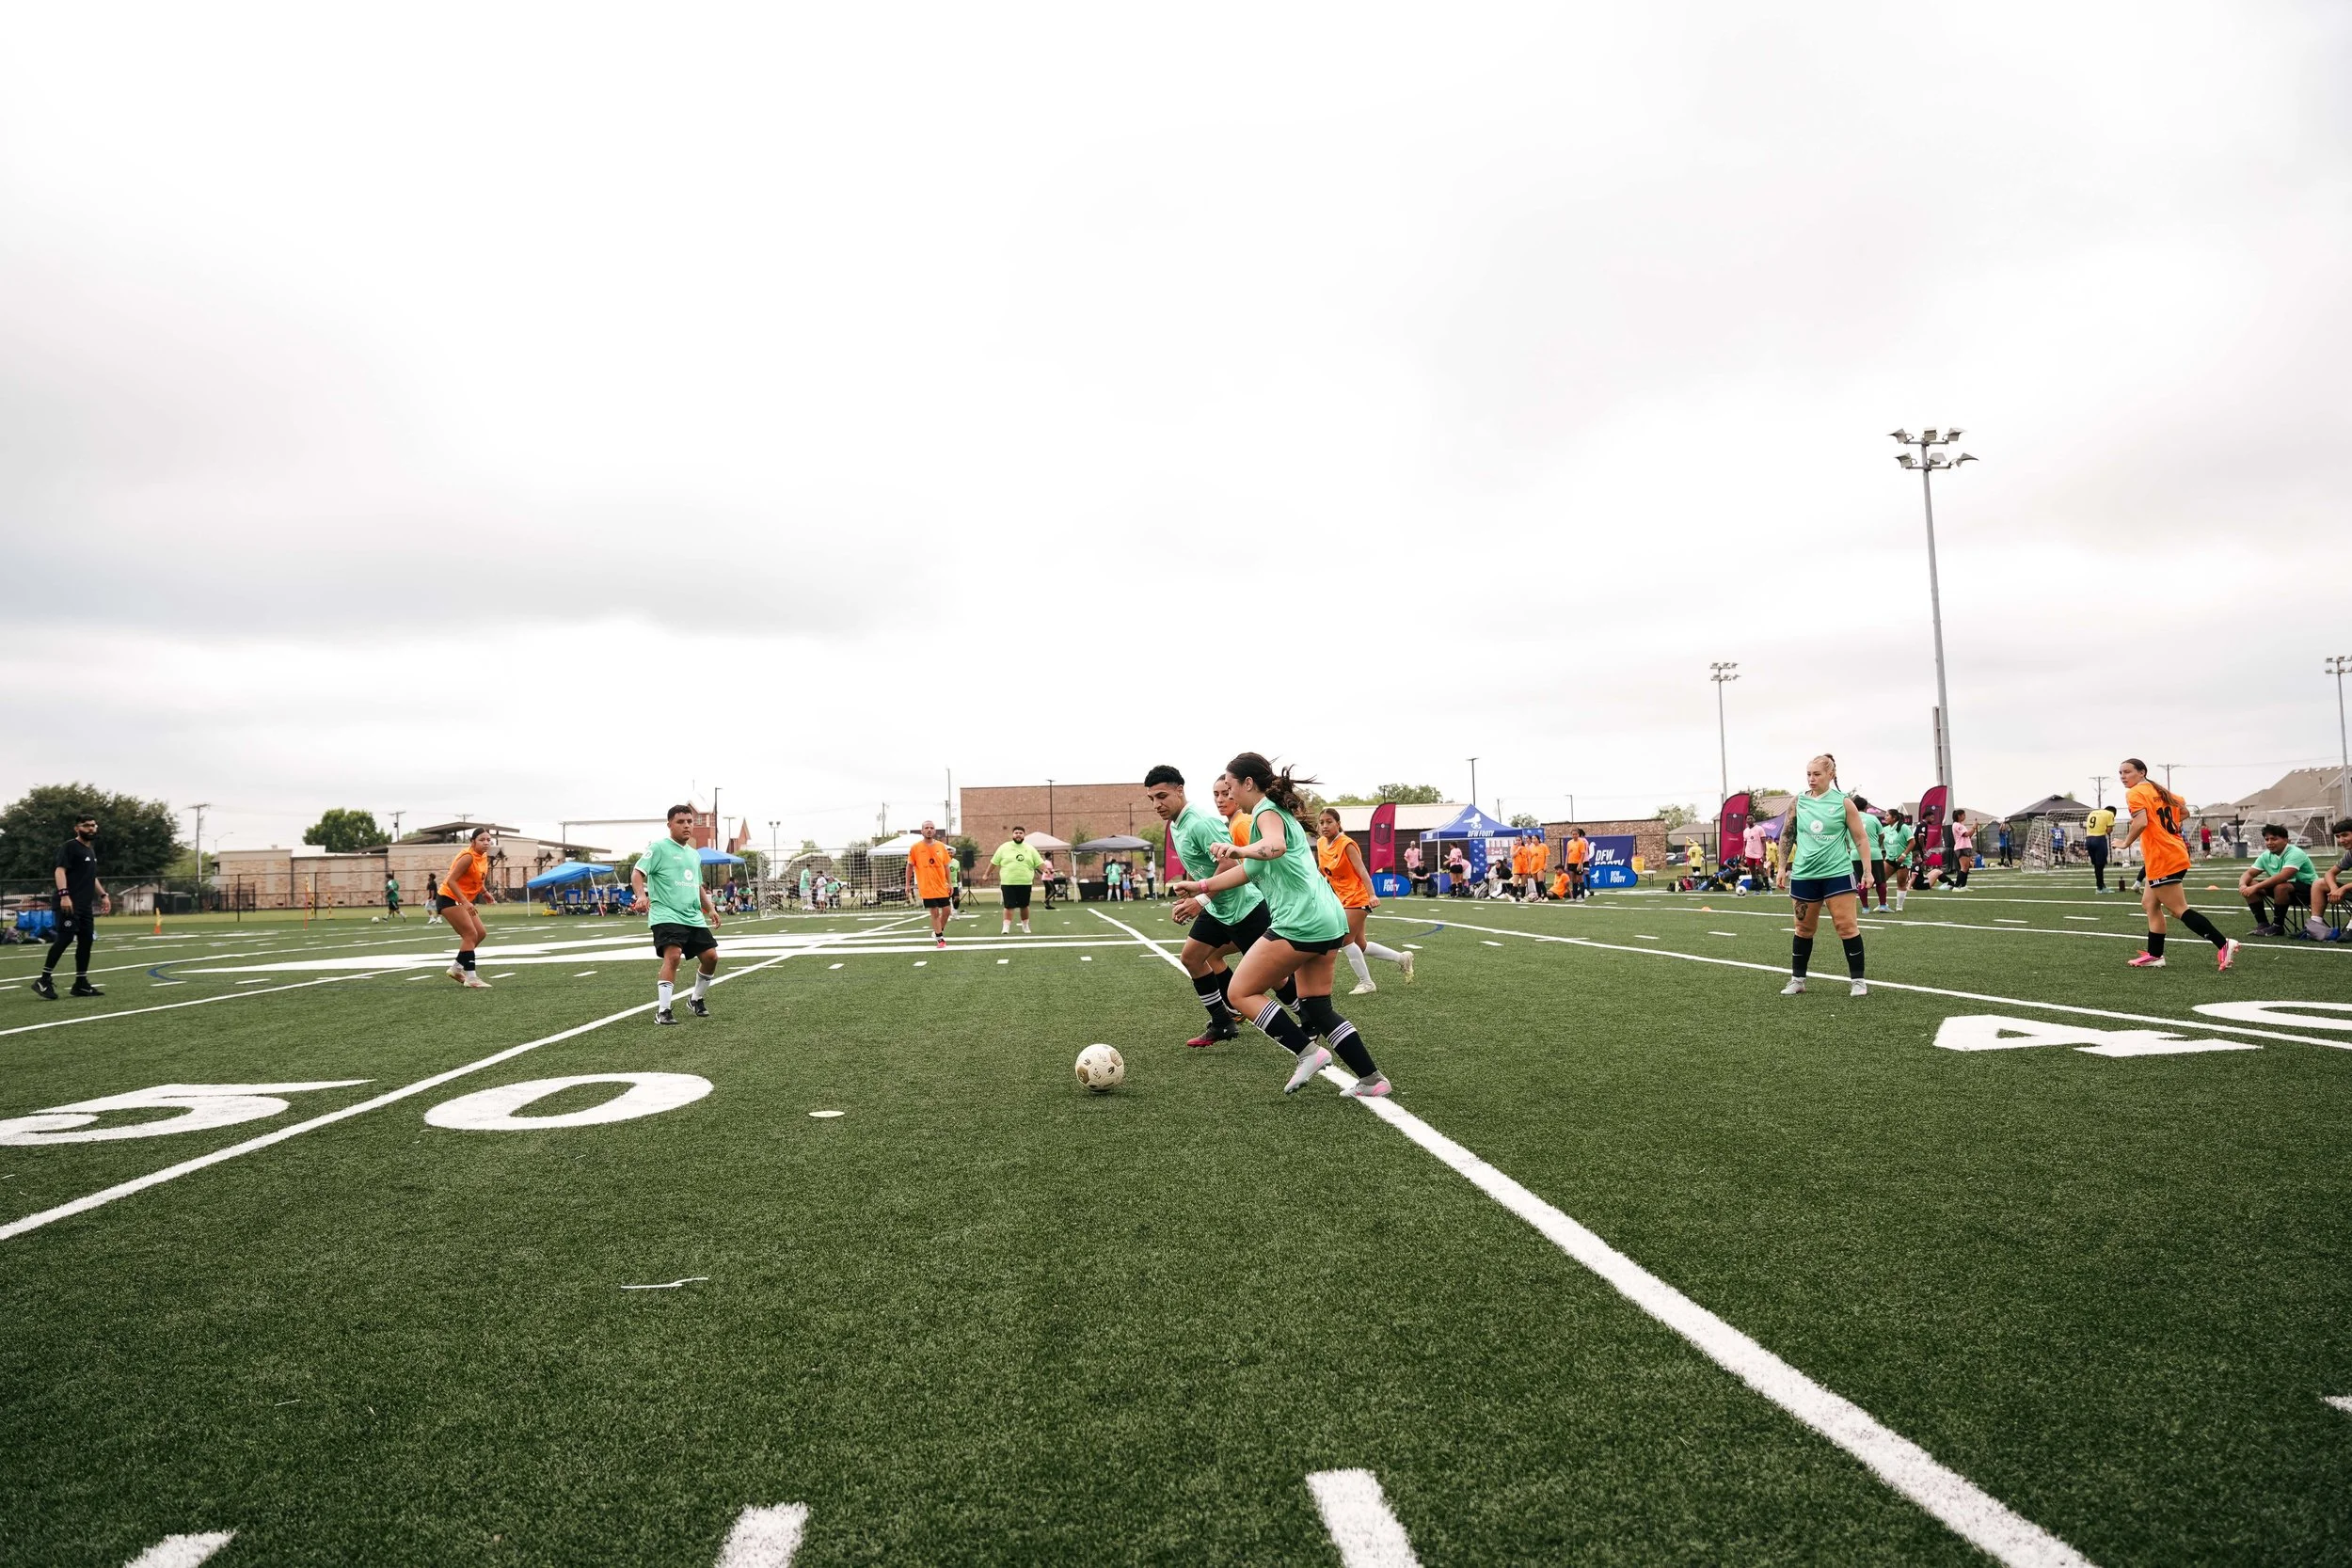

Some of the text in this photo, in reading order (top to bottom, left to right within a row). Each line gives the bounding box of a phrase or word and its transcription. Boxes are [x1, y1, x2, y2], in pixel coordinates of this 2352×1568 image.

[2090, 816, 2097, 829] 9
[1468, 830, 1479, 838] DFW
[2054, 832, 2062, 840] 21
[1595, 848, 1615, 862] DFW
[1610, 875, 1626, 883] FOOTY
